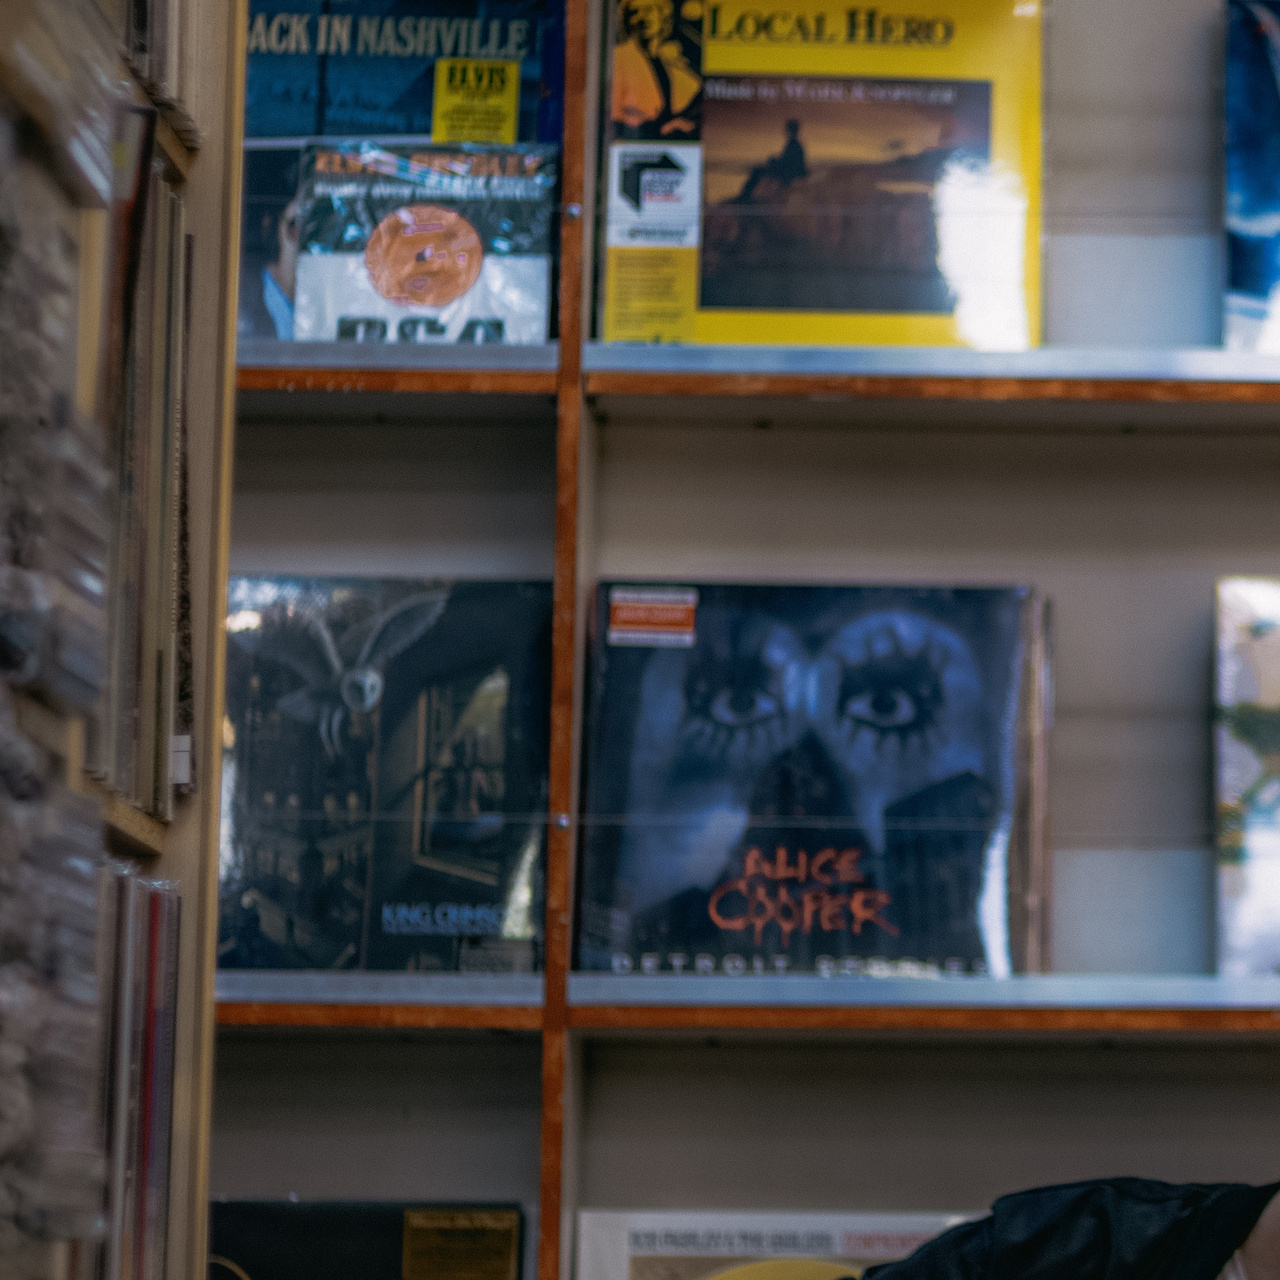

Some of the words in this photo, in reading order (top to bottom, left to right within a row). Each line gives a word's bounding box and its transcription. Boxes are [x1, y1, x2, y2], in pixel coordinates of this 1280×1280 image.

[249, 12, 312, 54] ACK
[316, 14, 351, 55] IN
[356, 16, 531, 59] NASHVILLE
[708, 4, 836, 44] LOCAL
[845, 9, 955, 47] HERO
[743, 845, 866, 885] ALICE
